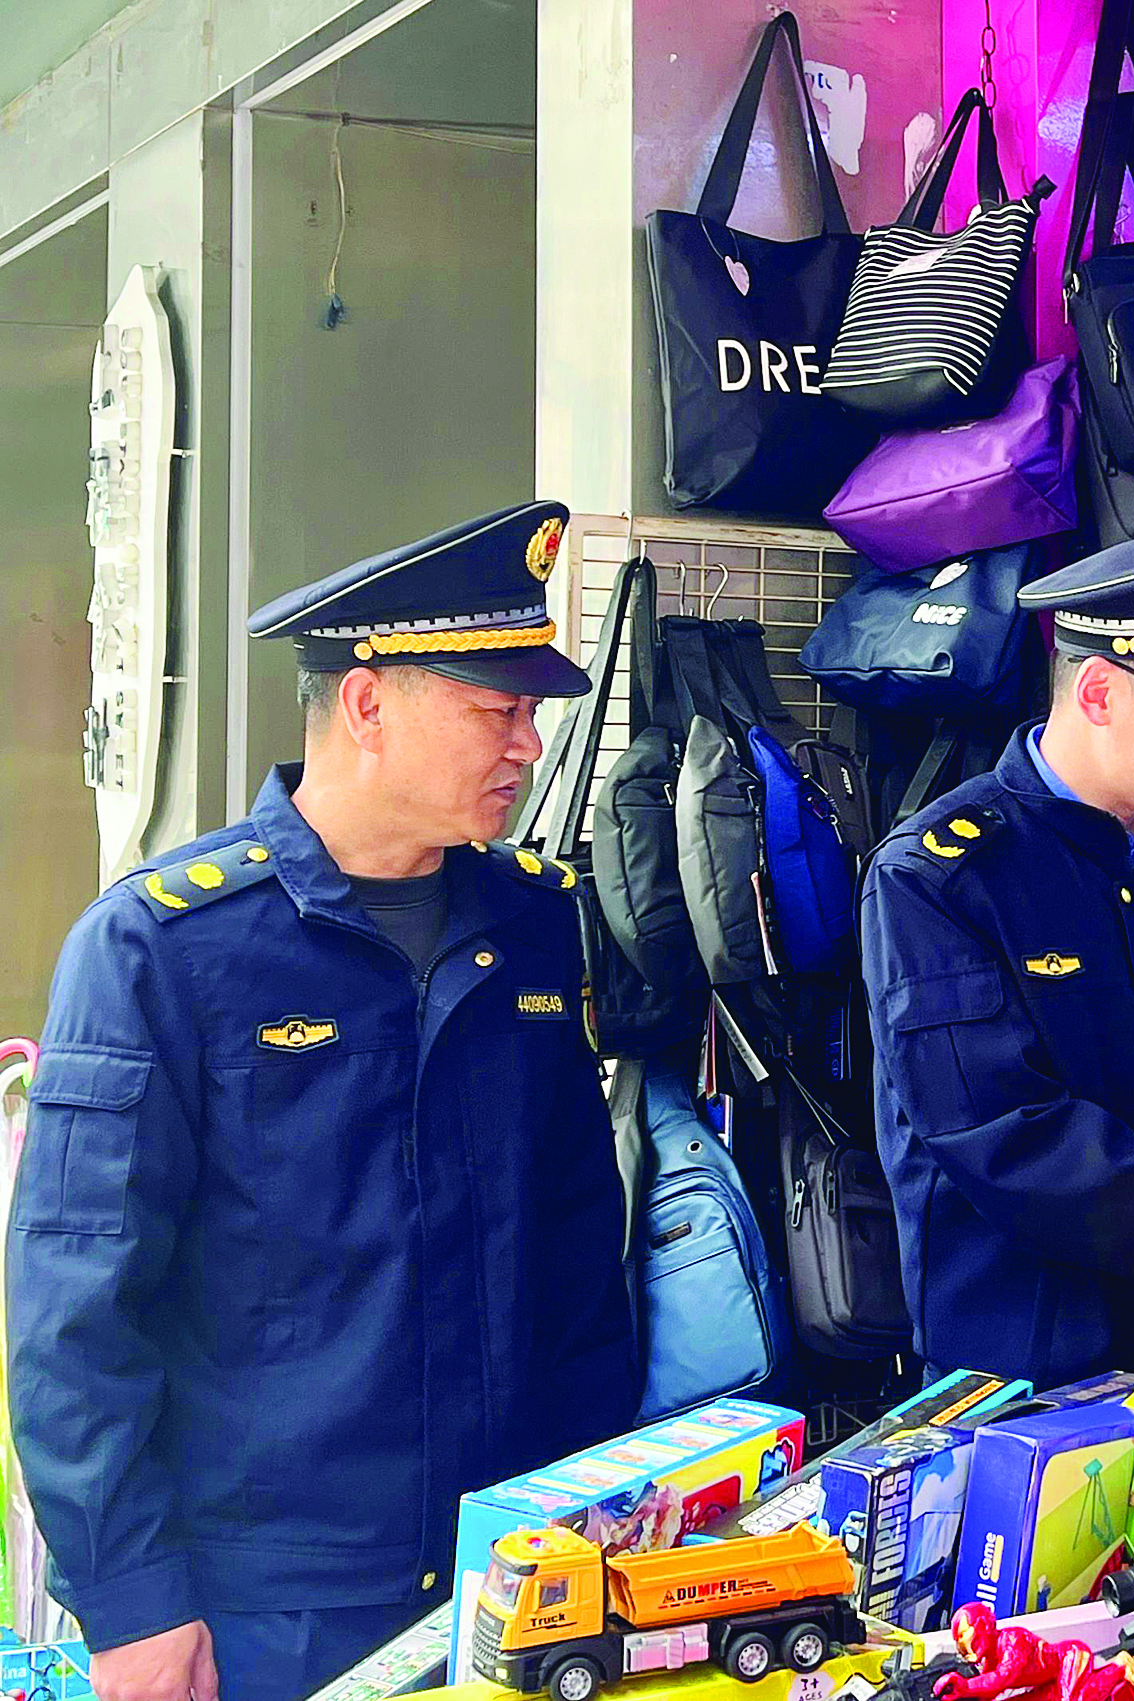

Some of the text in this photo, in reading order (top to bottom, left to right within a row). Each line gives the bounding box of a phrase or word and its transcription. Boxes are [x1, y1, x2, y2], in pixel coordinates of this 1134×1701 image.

[717, 339, 822, 395] DRE
[517, 995, 563, 1013] 44090549
[871, 1469, 913, 1586] FORCES
[979, 1532, 998, 1581] Game
[677, 1580, 738, 1601] DUMPER
[530, 1613, 566, 1627] Truck
